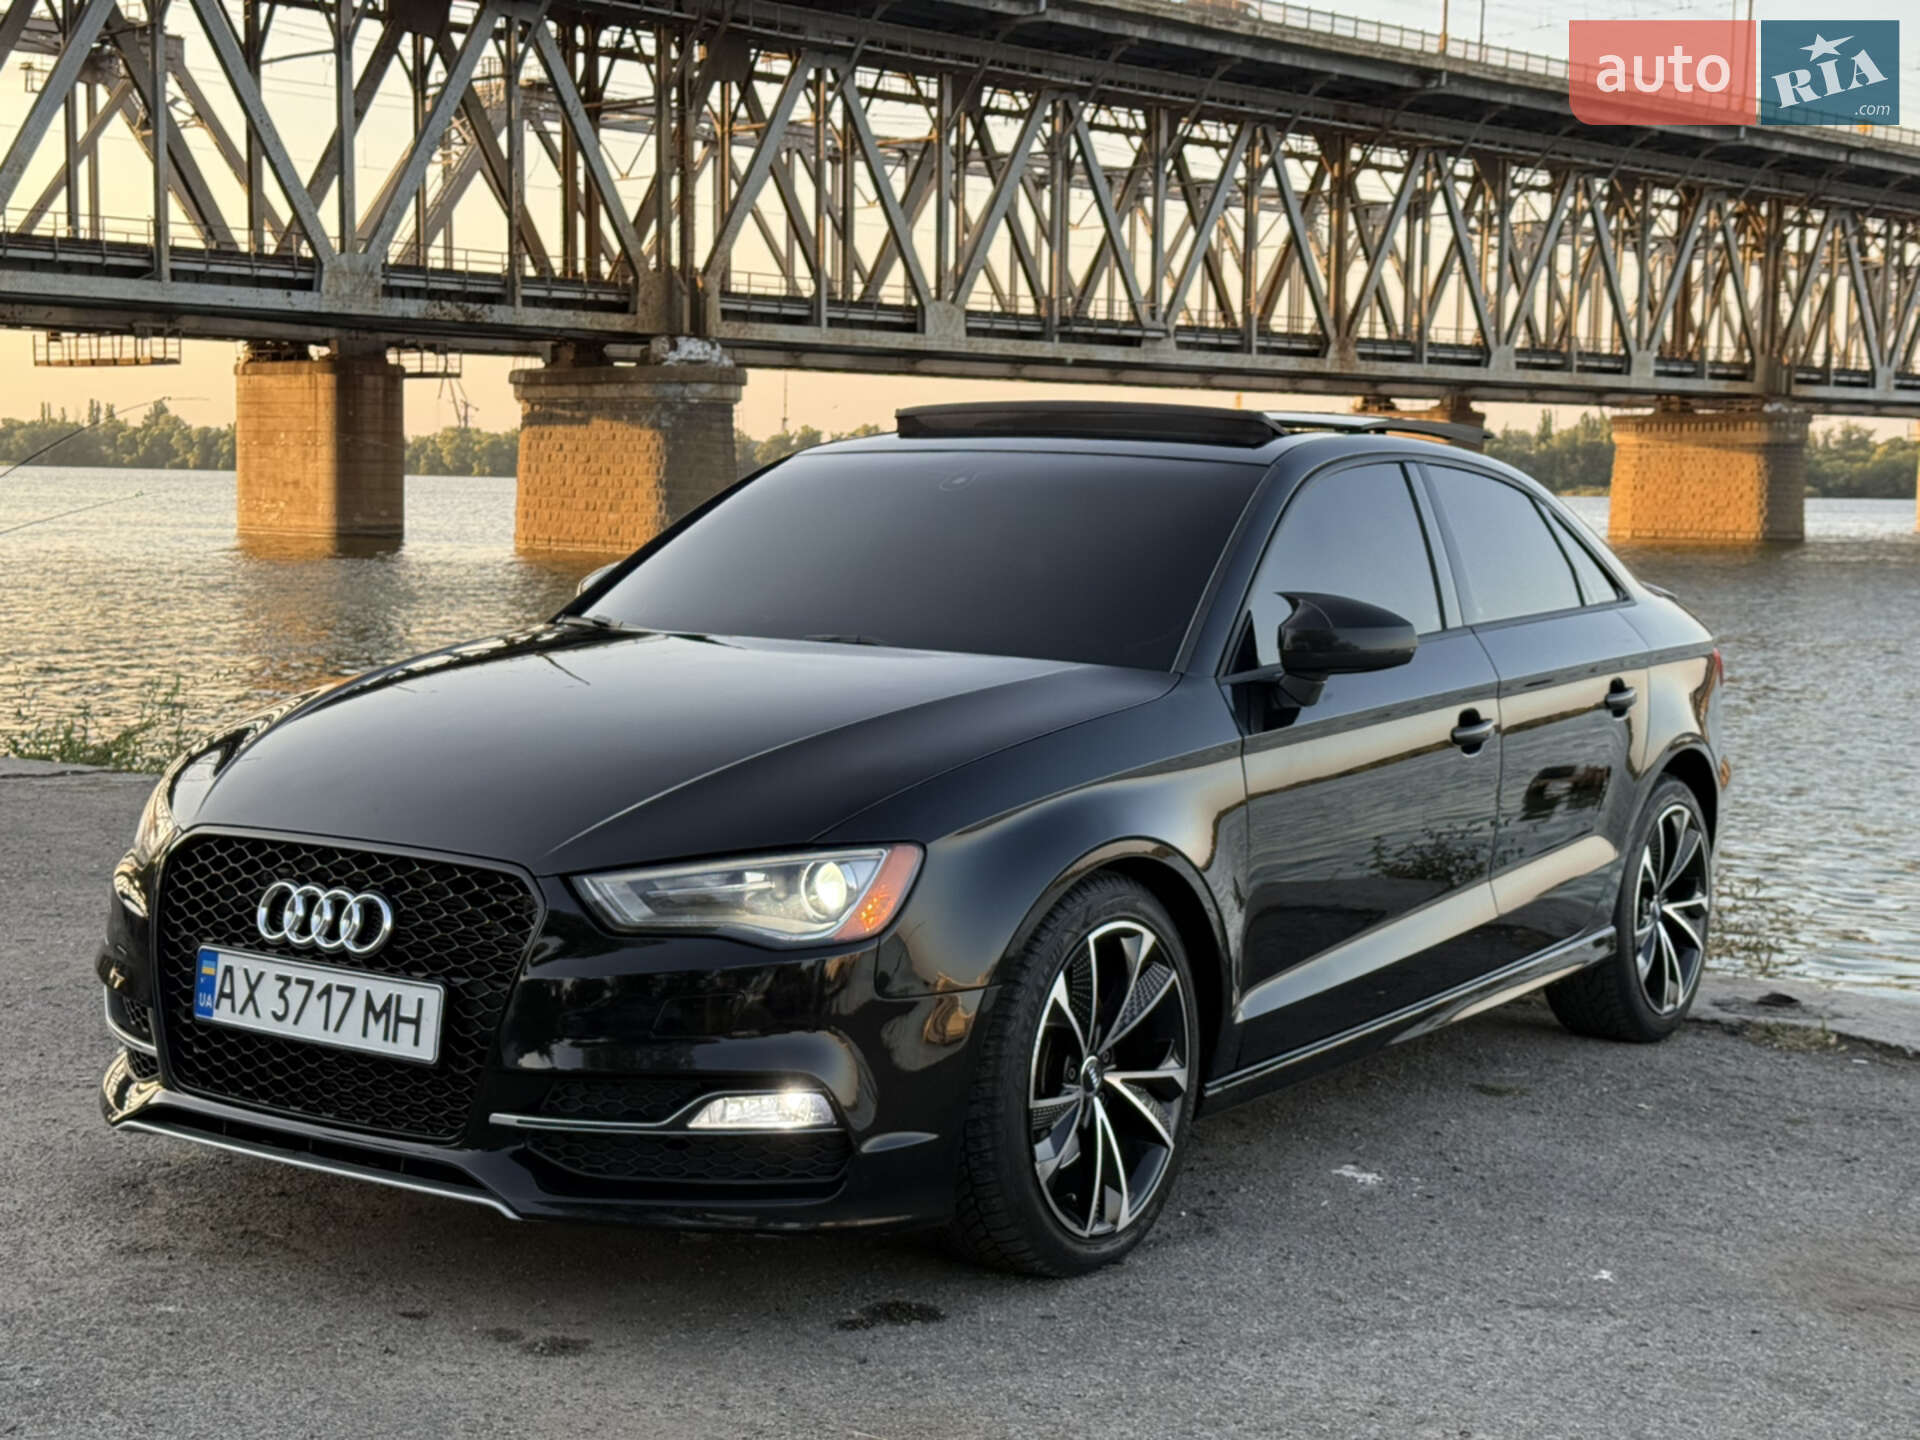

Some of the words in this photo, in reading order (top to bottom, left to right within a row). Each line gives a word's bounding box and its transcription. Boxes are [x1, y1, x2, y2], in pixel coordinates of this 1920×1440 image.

[198, 992, 213, 1009] UA
[215, 965, 266, 1018] AX
[271, 974, 357, 1033] 3717
[361, 989, 424, 1047] MH
